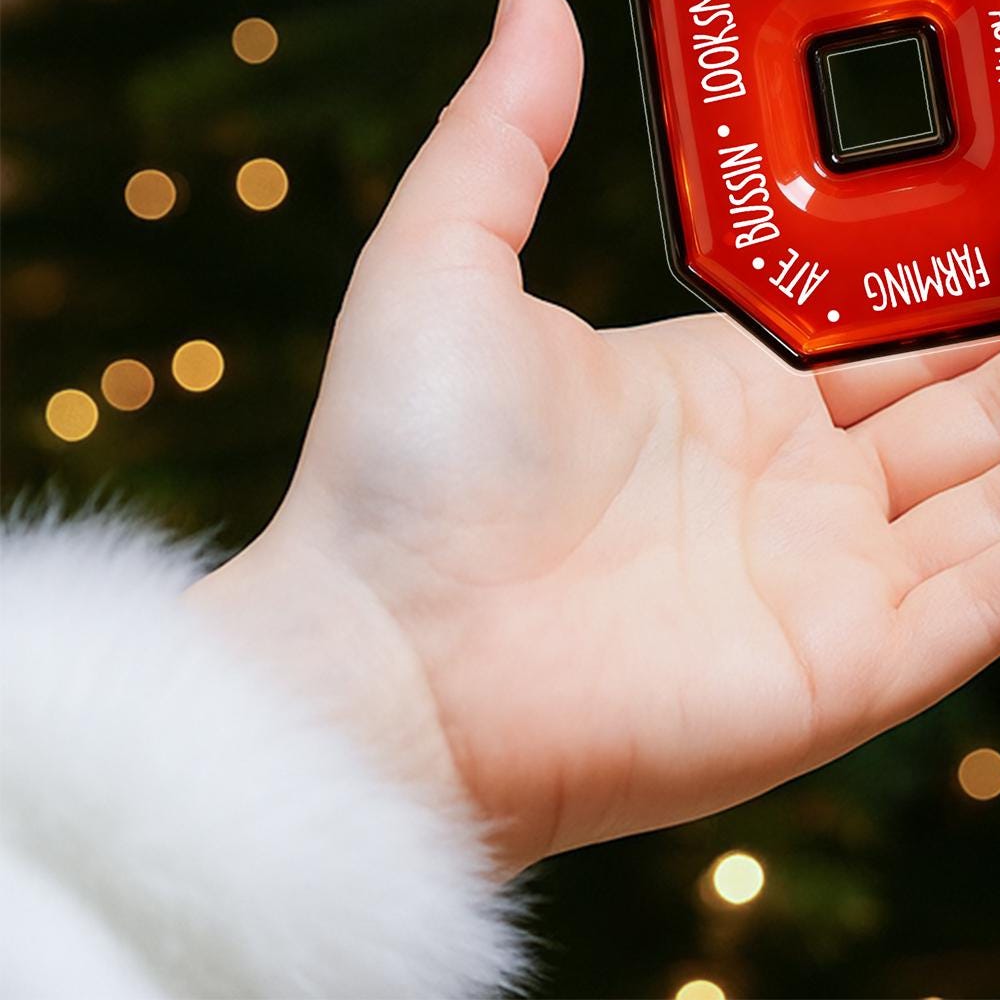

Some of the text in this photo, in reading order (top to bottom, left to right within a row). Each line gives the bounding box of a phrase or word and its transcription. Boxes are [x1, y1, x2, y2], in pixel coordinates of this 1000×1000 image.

[718, 141, 780, 249] BUSSIN
[769, 247, 829, 305] ATE
[864, 243, 991, 312] FARMING
